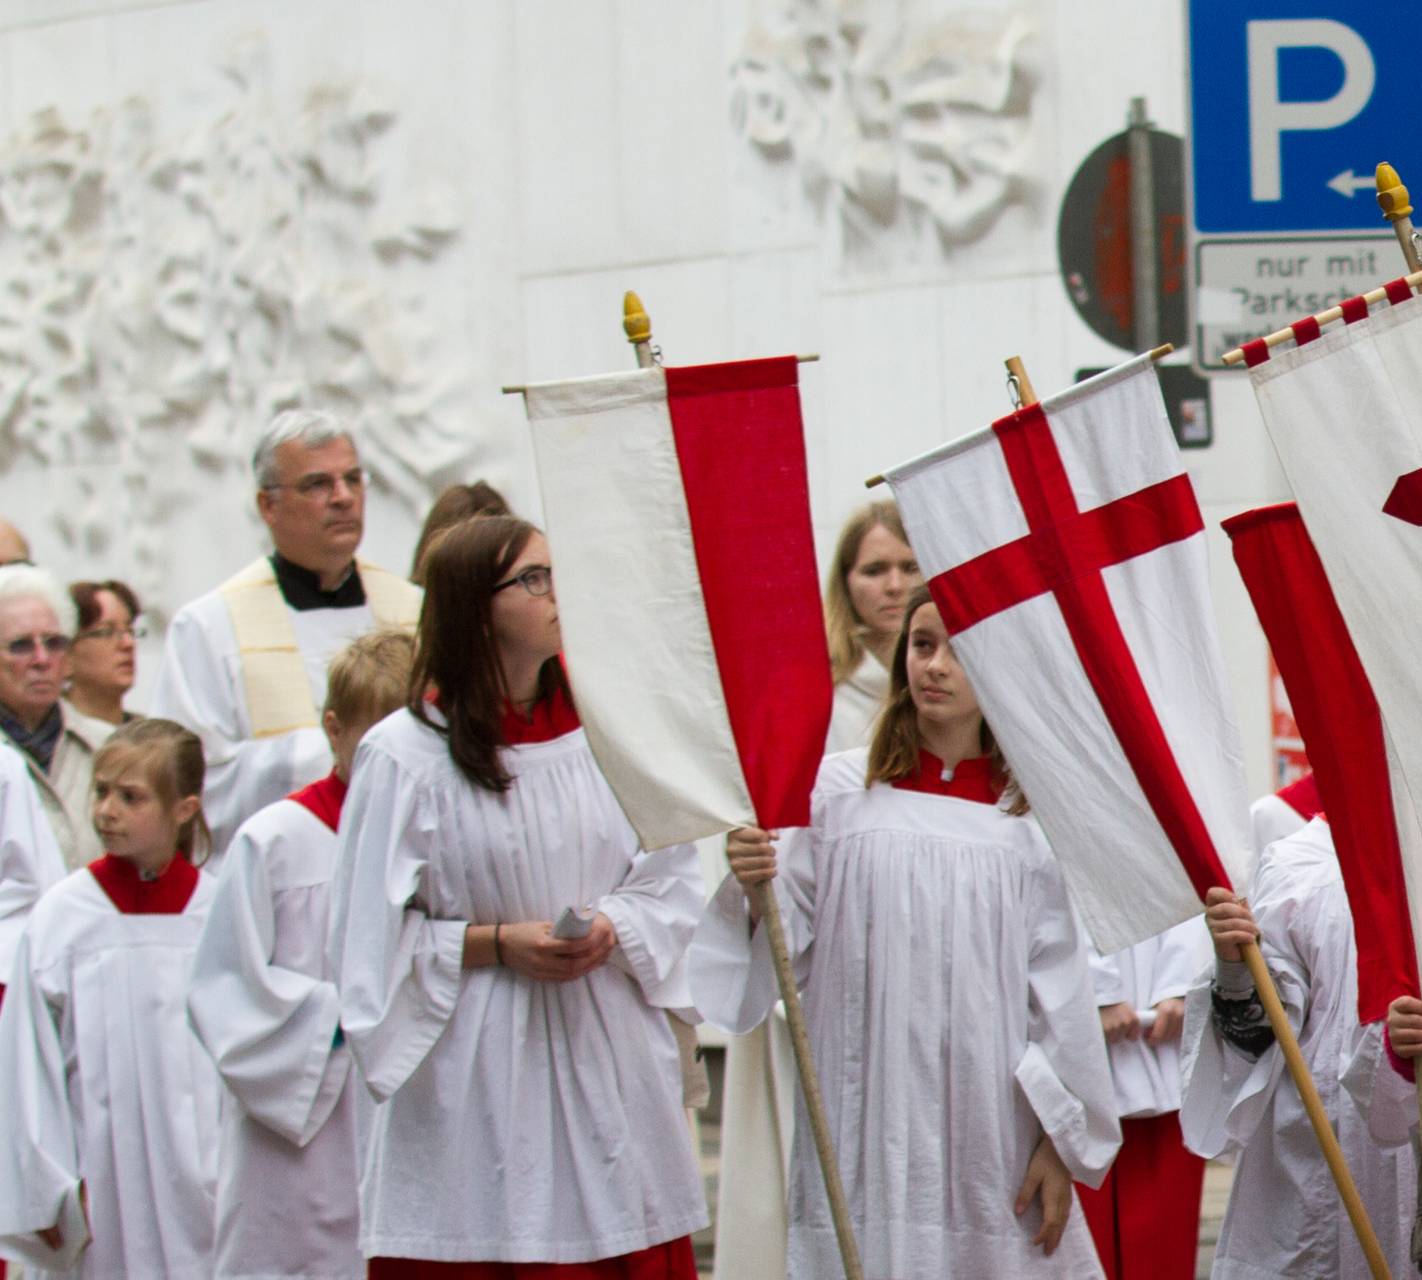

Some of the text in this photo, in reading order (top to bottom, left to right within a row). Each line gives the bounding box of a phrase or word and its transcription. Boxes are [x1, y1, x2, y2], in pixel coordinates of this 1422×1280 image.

[1247, 19, 1376, 202] P
[1257, 251, 1376, 277] nur mit
